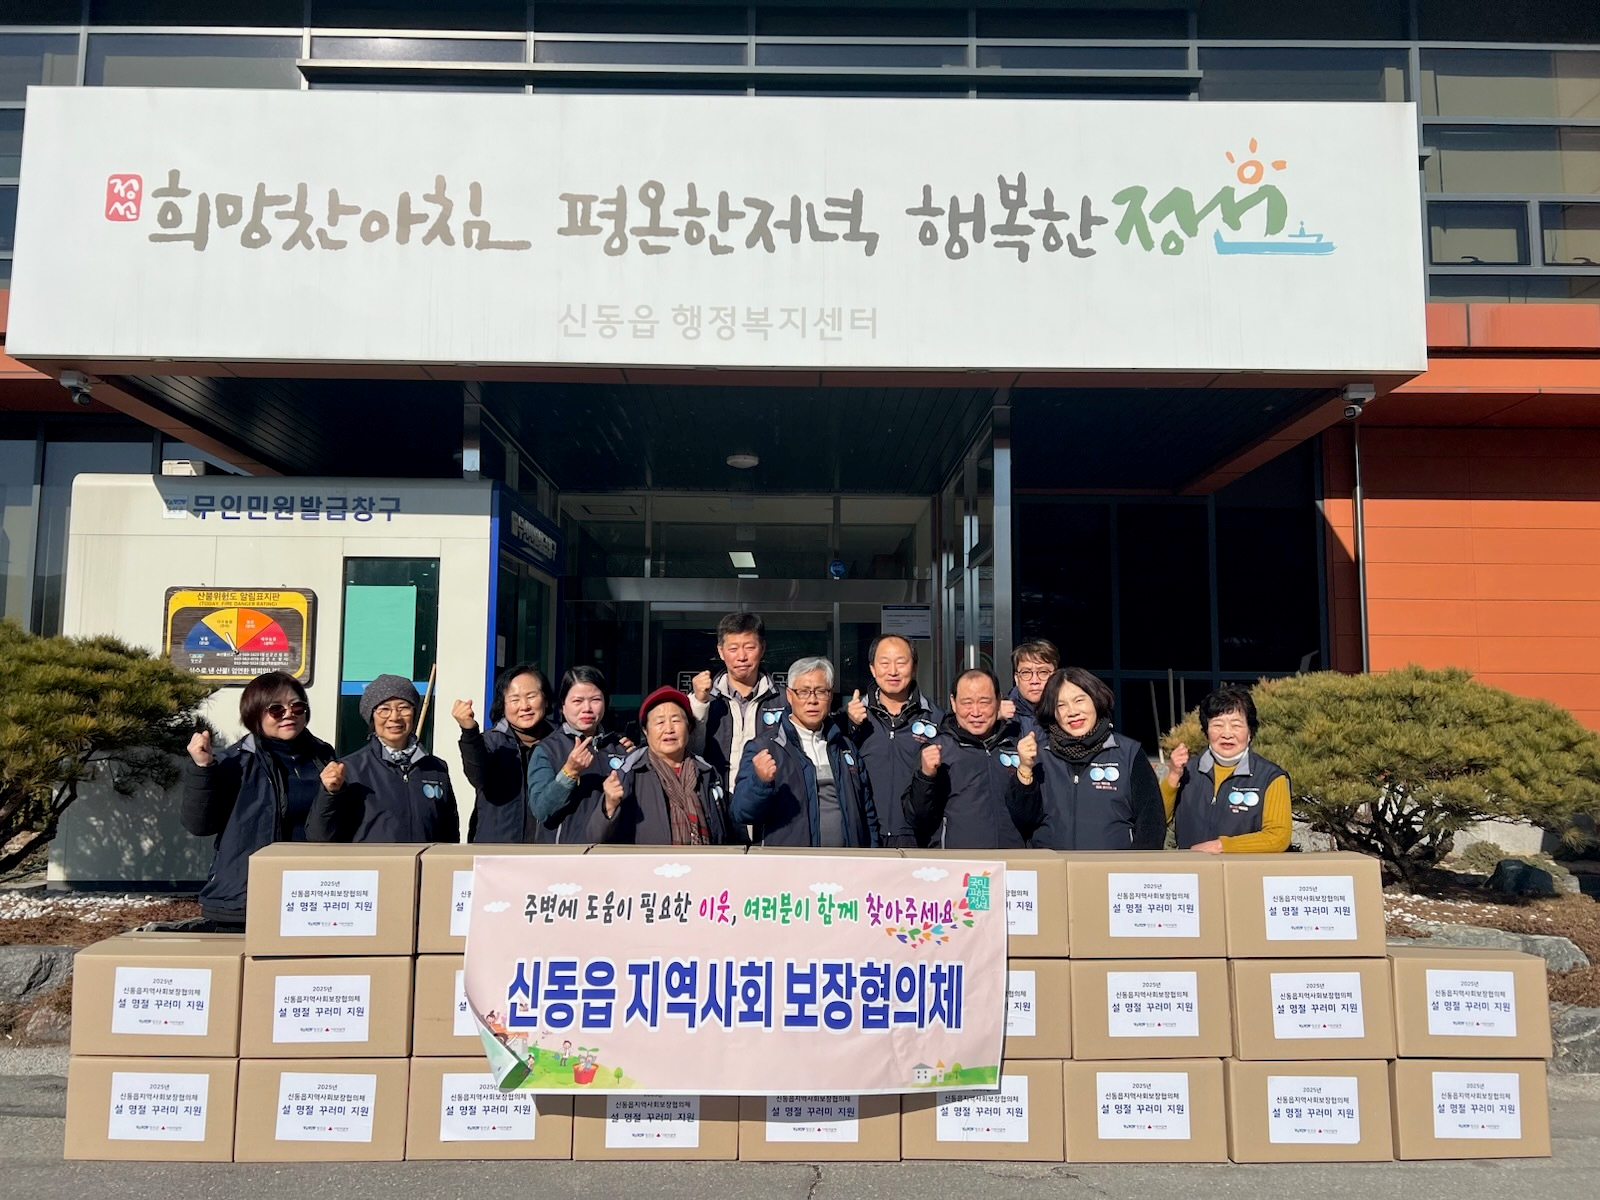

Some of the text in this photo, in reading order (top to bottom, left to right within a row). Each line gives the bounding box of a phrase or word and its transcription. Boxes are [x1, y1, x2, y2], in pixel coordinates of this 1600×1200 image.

[557, 303, 879, 342] 신동읍 행정복지센터
[193, 495, 401, 522] 무인민원발급창구
[197, 592, 280, 601] 산불위험도 알림표지판
[291, 890, 369, 898] 신동읍지역사회보장협의체
[1117, 892, 1190, 900] 신동읍지역사회보장협의체
[1272, 895, 1346, 903] 신동읍지역사회보장협의체
[286, 901, 373, 911] 설 명절 꾸러미 지원
[525, 889, 953, 927] 주변에 도움이 필요한 이웃, 여러분이 함께 찾아주세요
[1016, 901, 1033, 911] 지원
[1113, 903, 1194, 914] 설 명절 꾸러미 지원
[1269, 906, 1351, 916] 설 명절 꾸러미 지원
[123, 987, 201, 996] 신동읍지역사회보장협의체
[508, 961, 964, 1030] 신동읍 지역사회 보장협의체
[1116, 991, 1189, 999] 신동읍지역사회보장협의체
[1280, 992, 1353, 1000] 신동읍지역사회보장협의체
[1435, 989, 1506, 998] 신동읍지역사회보장협의체
[283, 995, 361, 1003] 신동읍지역사회보장협의체
[117, 998, 204, 1011] 설 명절 꾸러미 지원
[1014, 1002, 1031, 1012] 지원
[1112, 1002, 1193, 1013] 설 명절 꾸러미 지원
[1276, 1003, 1358, 1014] 설 명절 꾸러미 지원
[1431, 1001, 1511, 1013] 설 명절 꾸러미 지원
[278, 1007, 365, 1017] 설 명절 꾸러미 지원
[119, 1093, 198, 1102] 신동읍지역사회보장협의체
[287, 1093, 366, 1102] 신동읍지역사회보장협의체
[450, 1093, 527, 1101] 신동읍지역사회보장협의체
[1105, 1092, 1180, 1100] 신동읍지역사회보장협의체
[1276, 1096, 1350, 1104] 신동읍지역사회보장협의체
[1441, 1092, 1511, 1100] 신동읍지역사회보장협의체
[114, 1104, 202, 1116] 설 명절 꾸러미 지원
[445, 1104, 531, 1116] 설 명절 꾸러미 지원
[615, 1101, 691, 1109] 신동읍지역사회보장협의체
[1101, 1104, 1185, 1115] 설 명절 꾸러미 지원
[1437, 1104, 1516, 1115] 설 명절 꾸러미 지원
[282, 1104, 369, 1117] 설 명절 꾸러미 지원
[771, 1106, 855, 1117] 설 명절 꾸러미 지원
[940, 1106, 1023, 1117] 설 명절 꾸러미 지원
[1272, 1108, 1355, 1119] 설 명절 꾸러미 지원
[610, 1112, 695, 1123] 설 명절 꾸러미 지원
